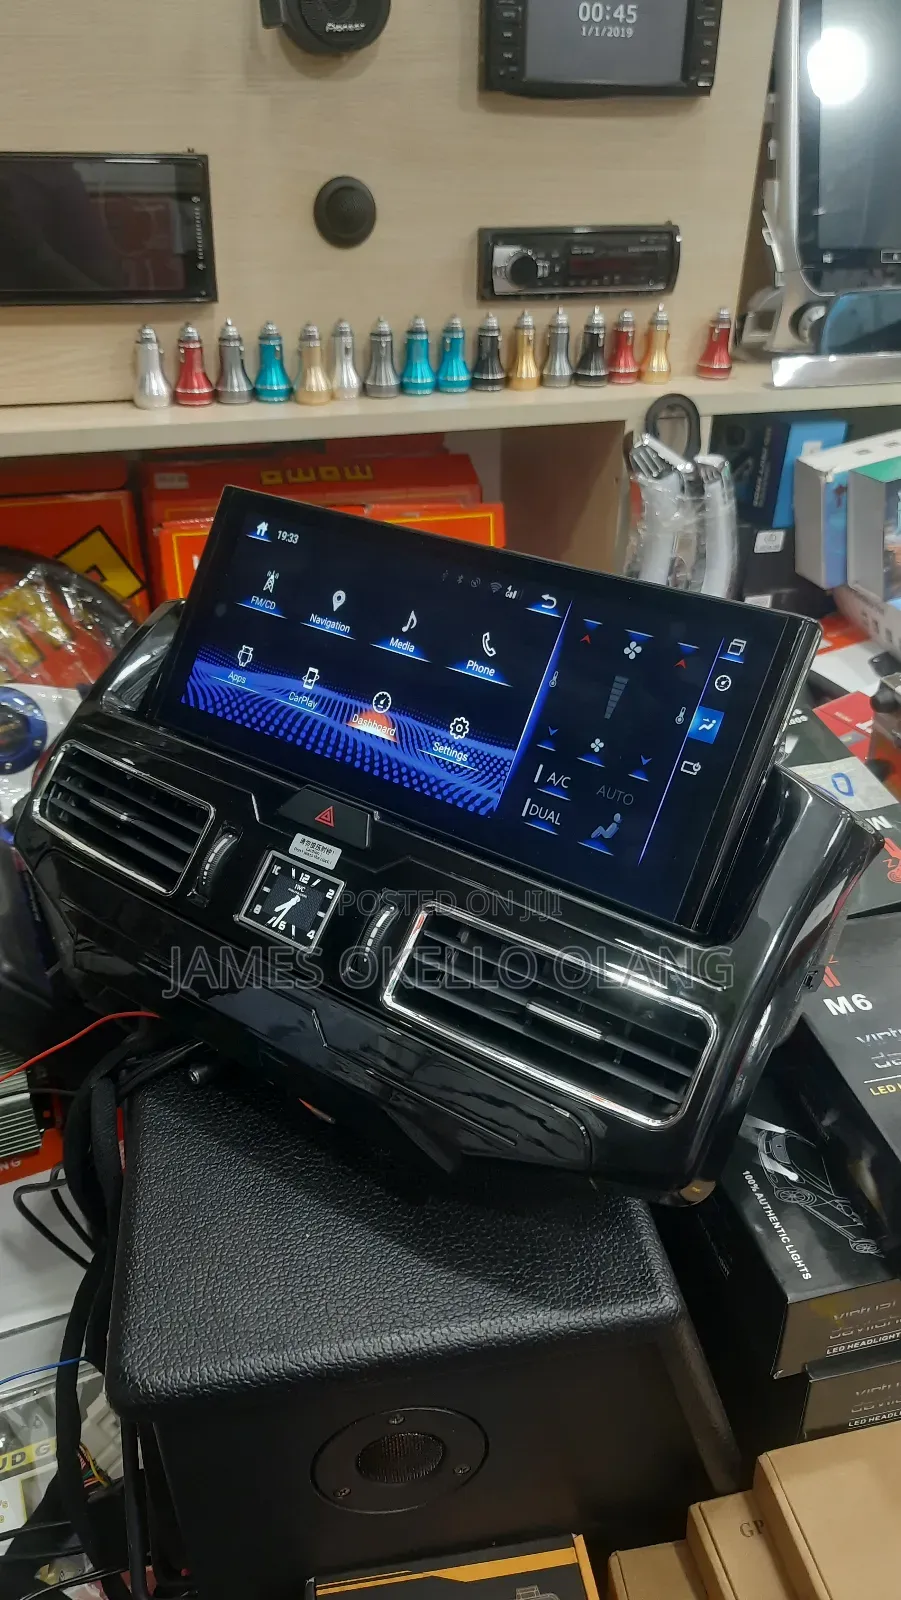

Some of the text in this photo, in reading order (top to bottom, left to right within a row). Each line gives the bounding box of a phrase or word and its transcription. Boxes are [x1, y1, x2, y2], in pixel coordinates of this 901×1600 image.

[578, 2, 638, 24] 00:45
[580, 26, 634, 39] 1/1/2019
[277, 530, 299, 544] 19:33
[250, 595, 276, 610] FM/CD
[309, 613, 351, 633] Navigation
[389, 637, 415, 653] Media
[466, 660, 496, 676] Phone
[227, 670, 247, 684] Apps
[288, 691, 319, 710] CarPlay
[351, 713, 397, 737] Dashboard
[432, 742, 469, 763] Settings
[546, 772, 571, 789] A/C
[596, 785, 634, 806] AUTO
[528, 803, 561, 826] DUAL
[299, 872, 311, 884] 12
[325, 888, 335, 900] 2
[278, 920, 287, 931] 6
[306, 929, 316, 940] 4
[823, 993, 873, 1016] M6
[869, 1084, 897, 1096] LED
[742, 1170, 812, 1280] 100% AUTHENTIC LIGHTS
[826, 1332, 901, 1355] LED HEADLIGHT
[848, 1418, 867, 1427] LED
